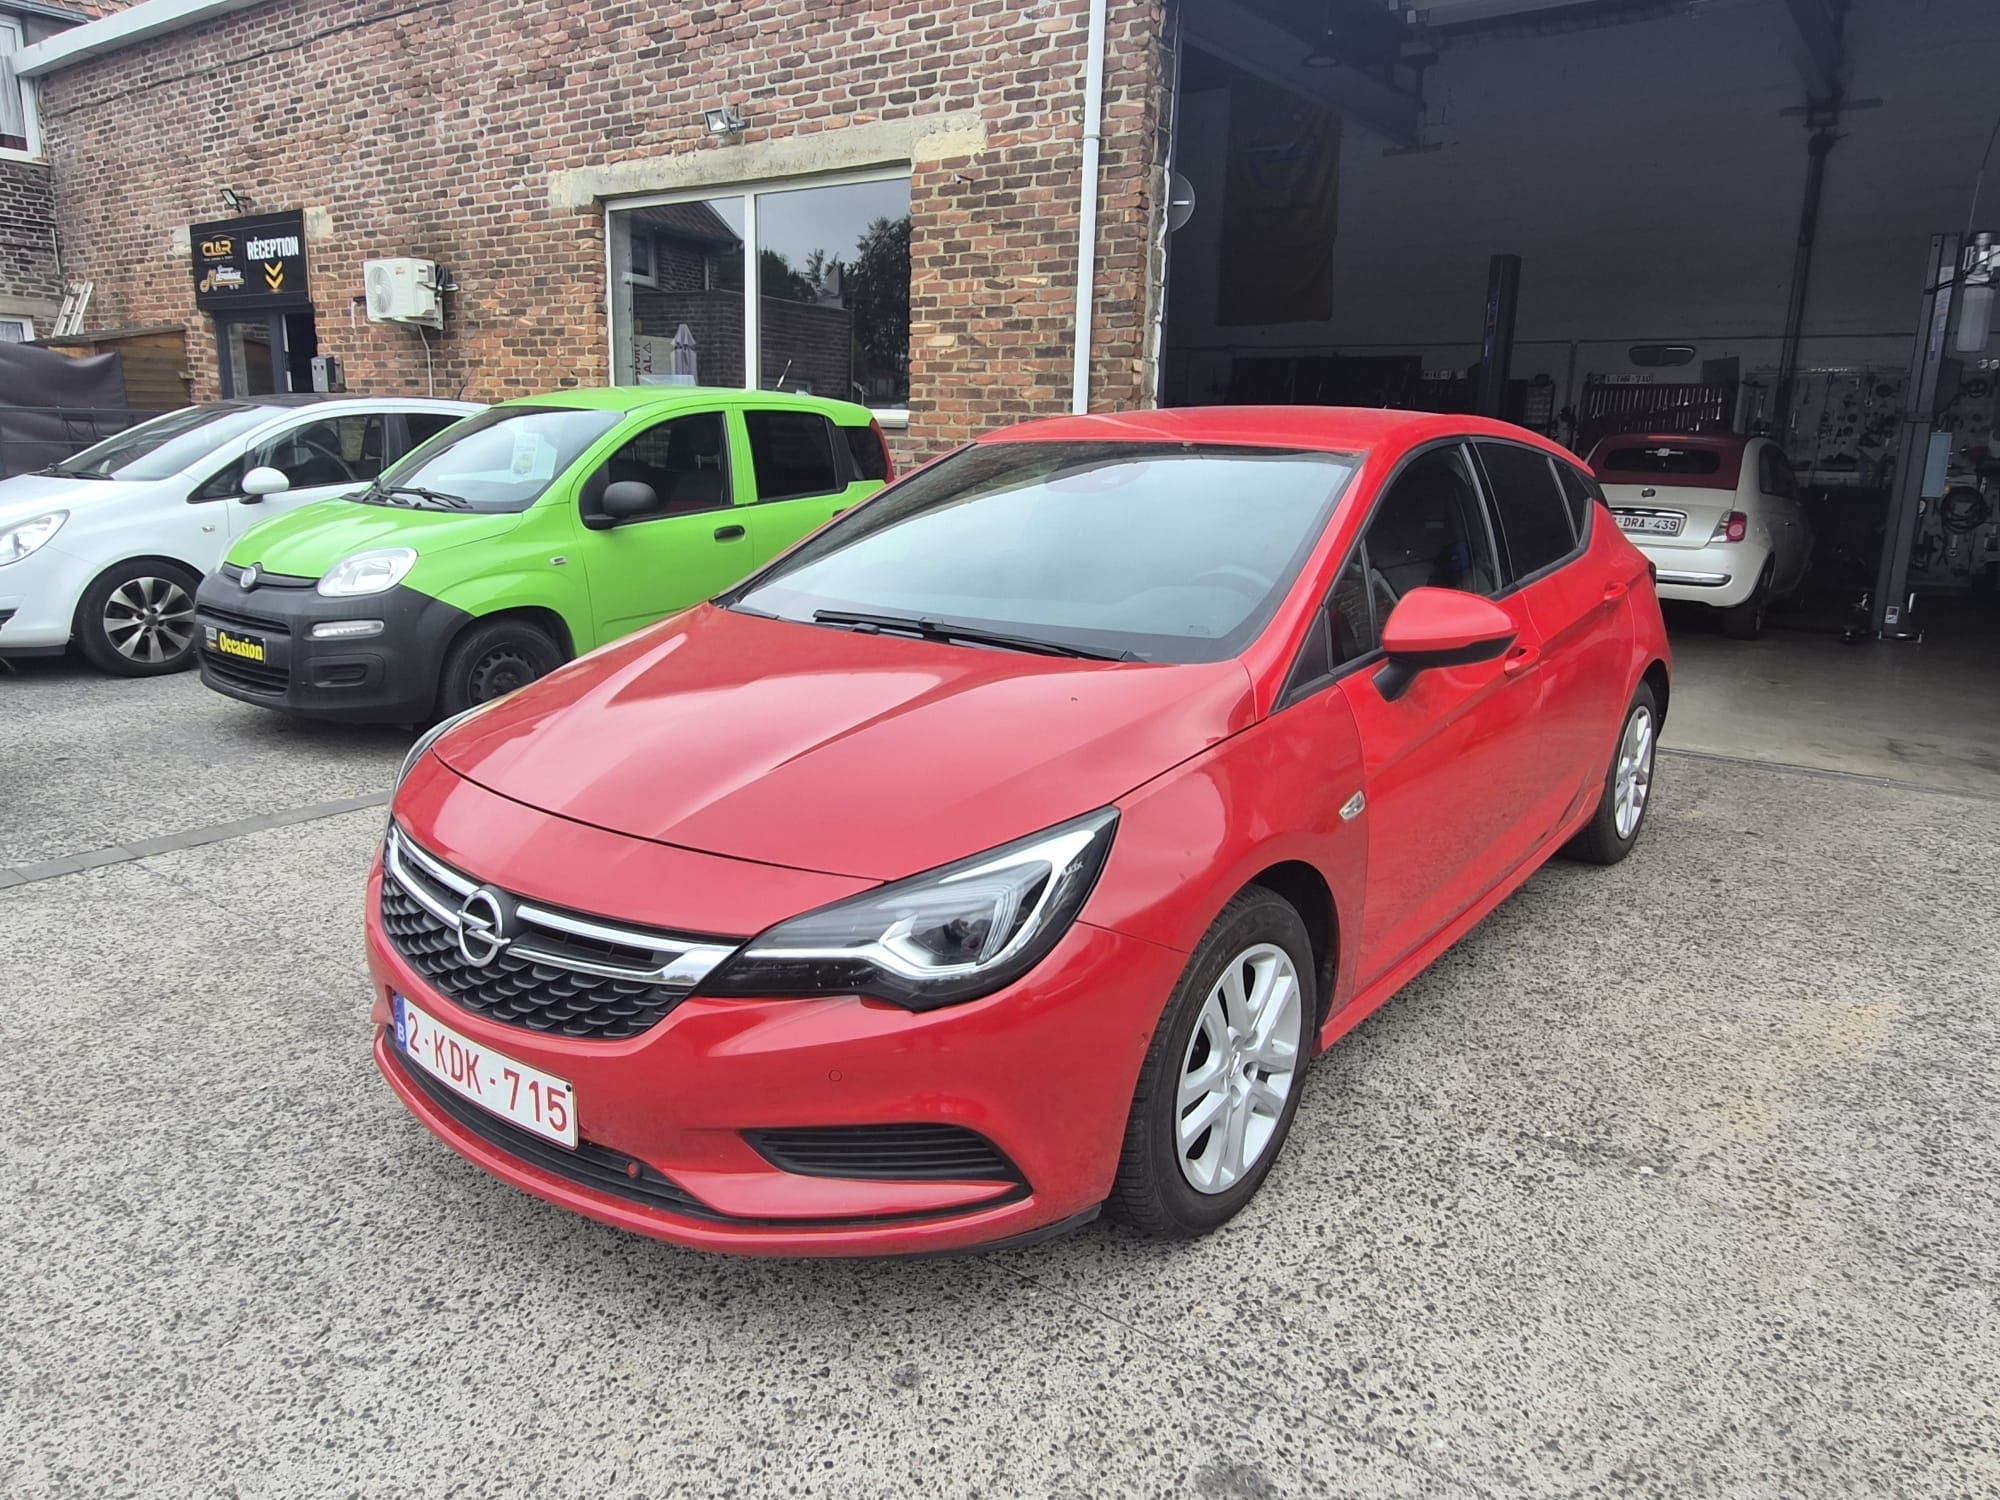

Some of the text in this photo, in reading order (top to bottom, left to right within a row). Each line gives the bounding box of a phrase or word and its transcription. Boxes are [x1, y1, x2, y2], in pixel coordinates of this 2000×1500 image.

[247, 236, 299, 260] RÉCEPTION
[220, 631, 263, 660] Occasion
[397, 1021, 405, 1042] B
[408, 1011, 567, 1132] 2-KDK-715
